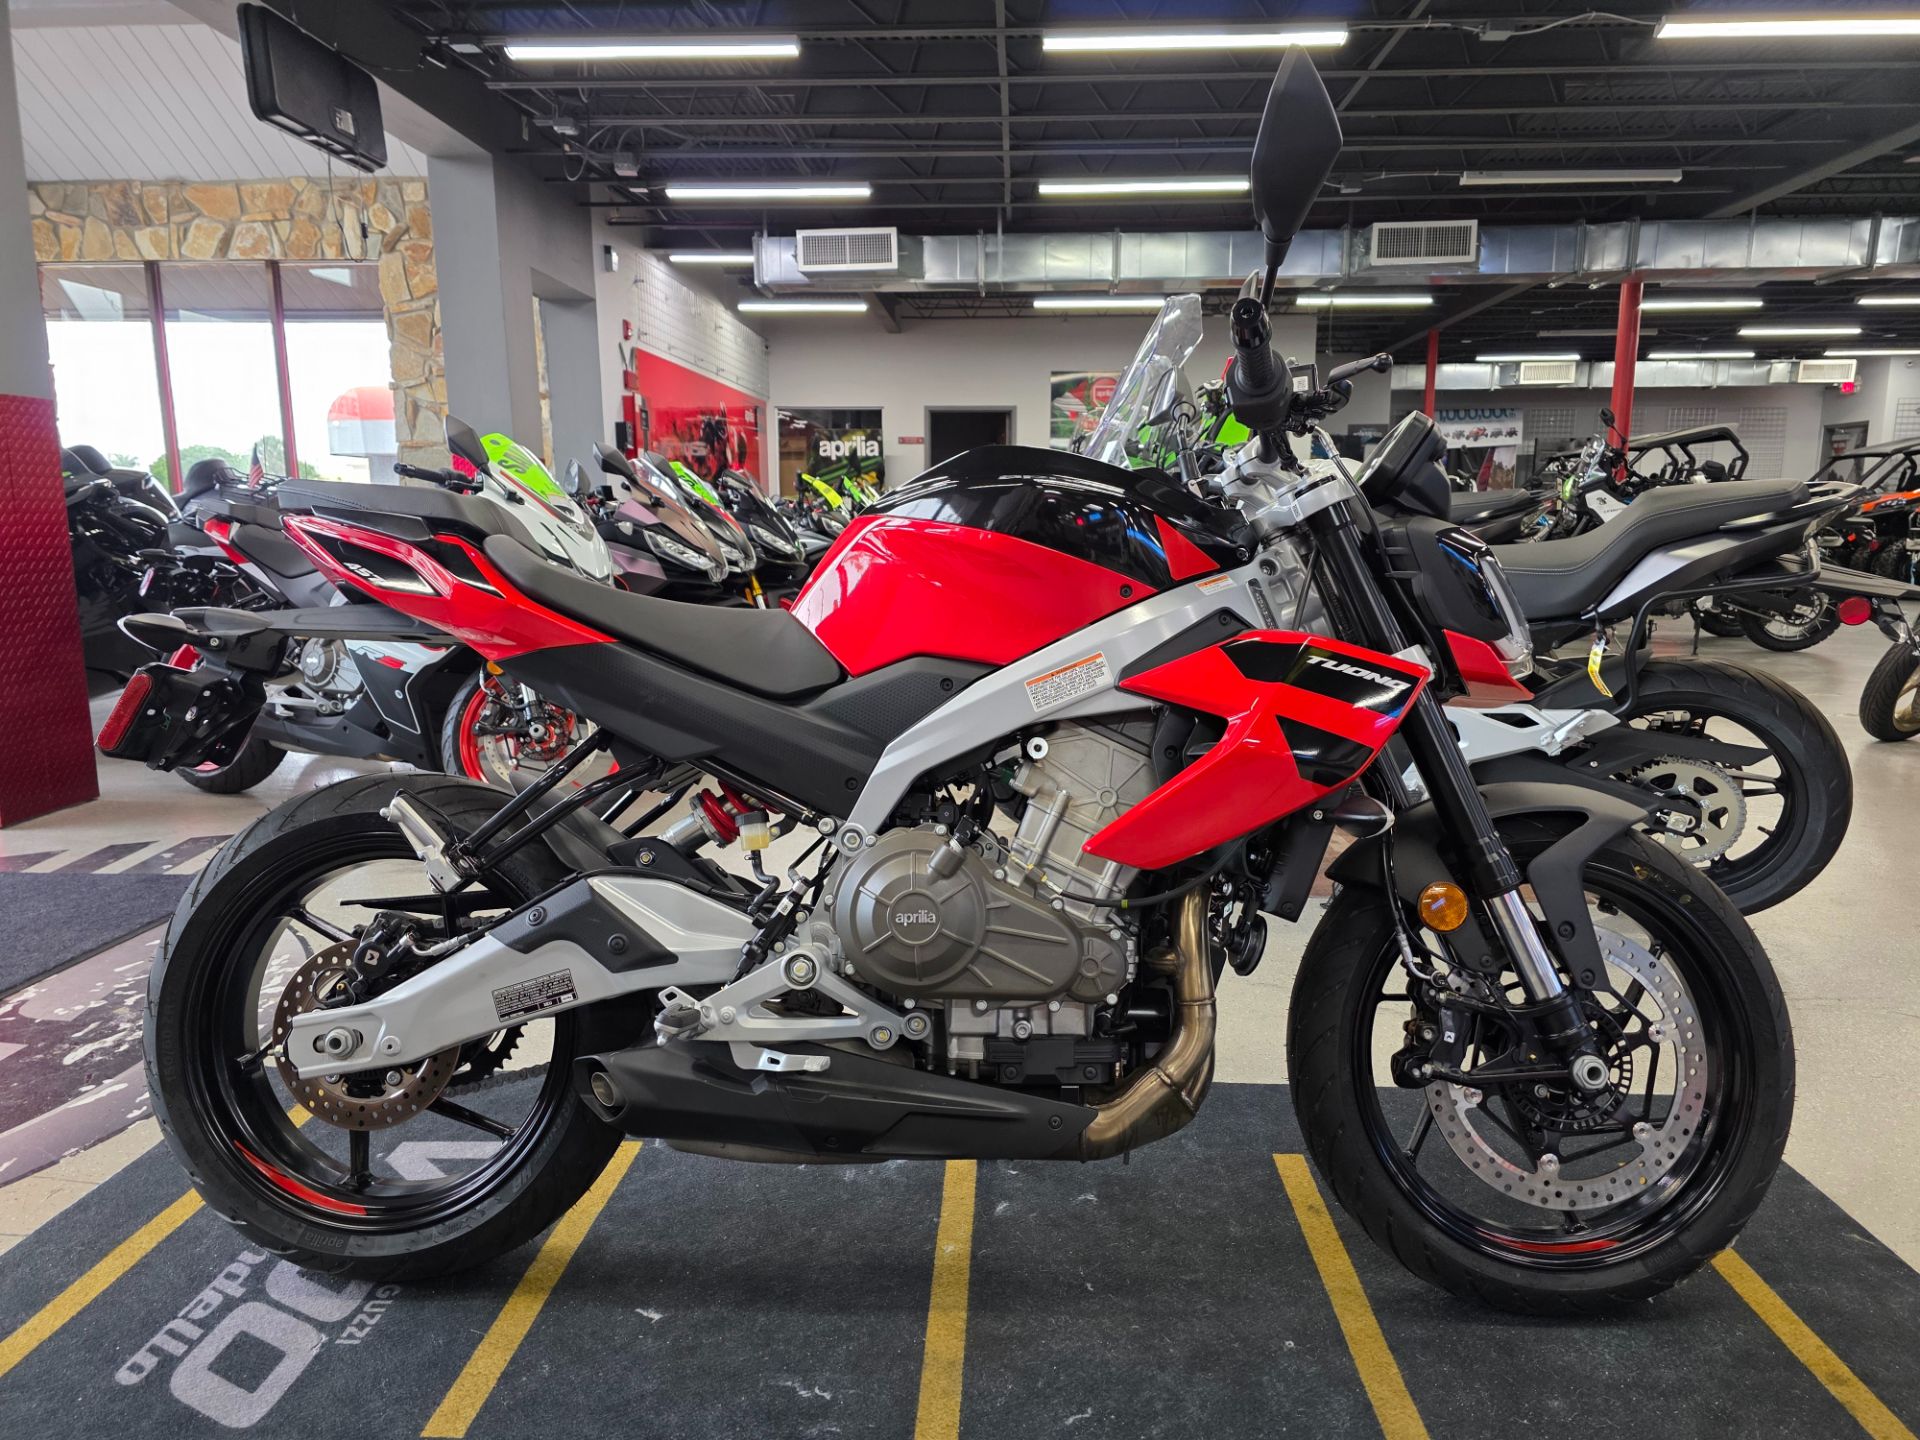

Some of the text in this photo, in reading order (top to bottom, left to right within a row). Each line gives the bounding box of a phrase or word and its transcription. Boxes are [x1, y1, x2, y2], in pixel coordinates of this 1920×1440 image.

[819, 436, 880, 461] aprilia
[343, 562, 386, 583] 457
[1306, 655, 1412, 690] TUONO
[895, 909, 936, 927] aprilia
[304, 1231, 344, 1250] aprilia
[114, 1248, 268, 1386] ndello
[335, 1285, 399, 1345] GUZZI
